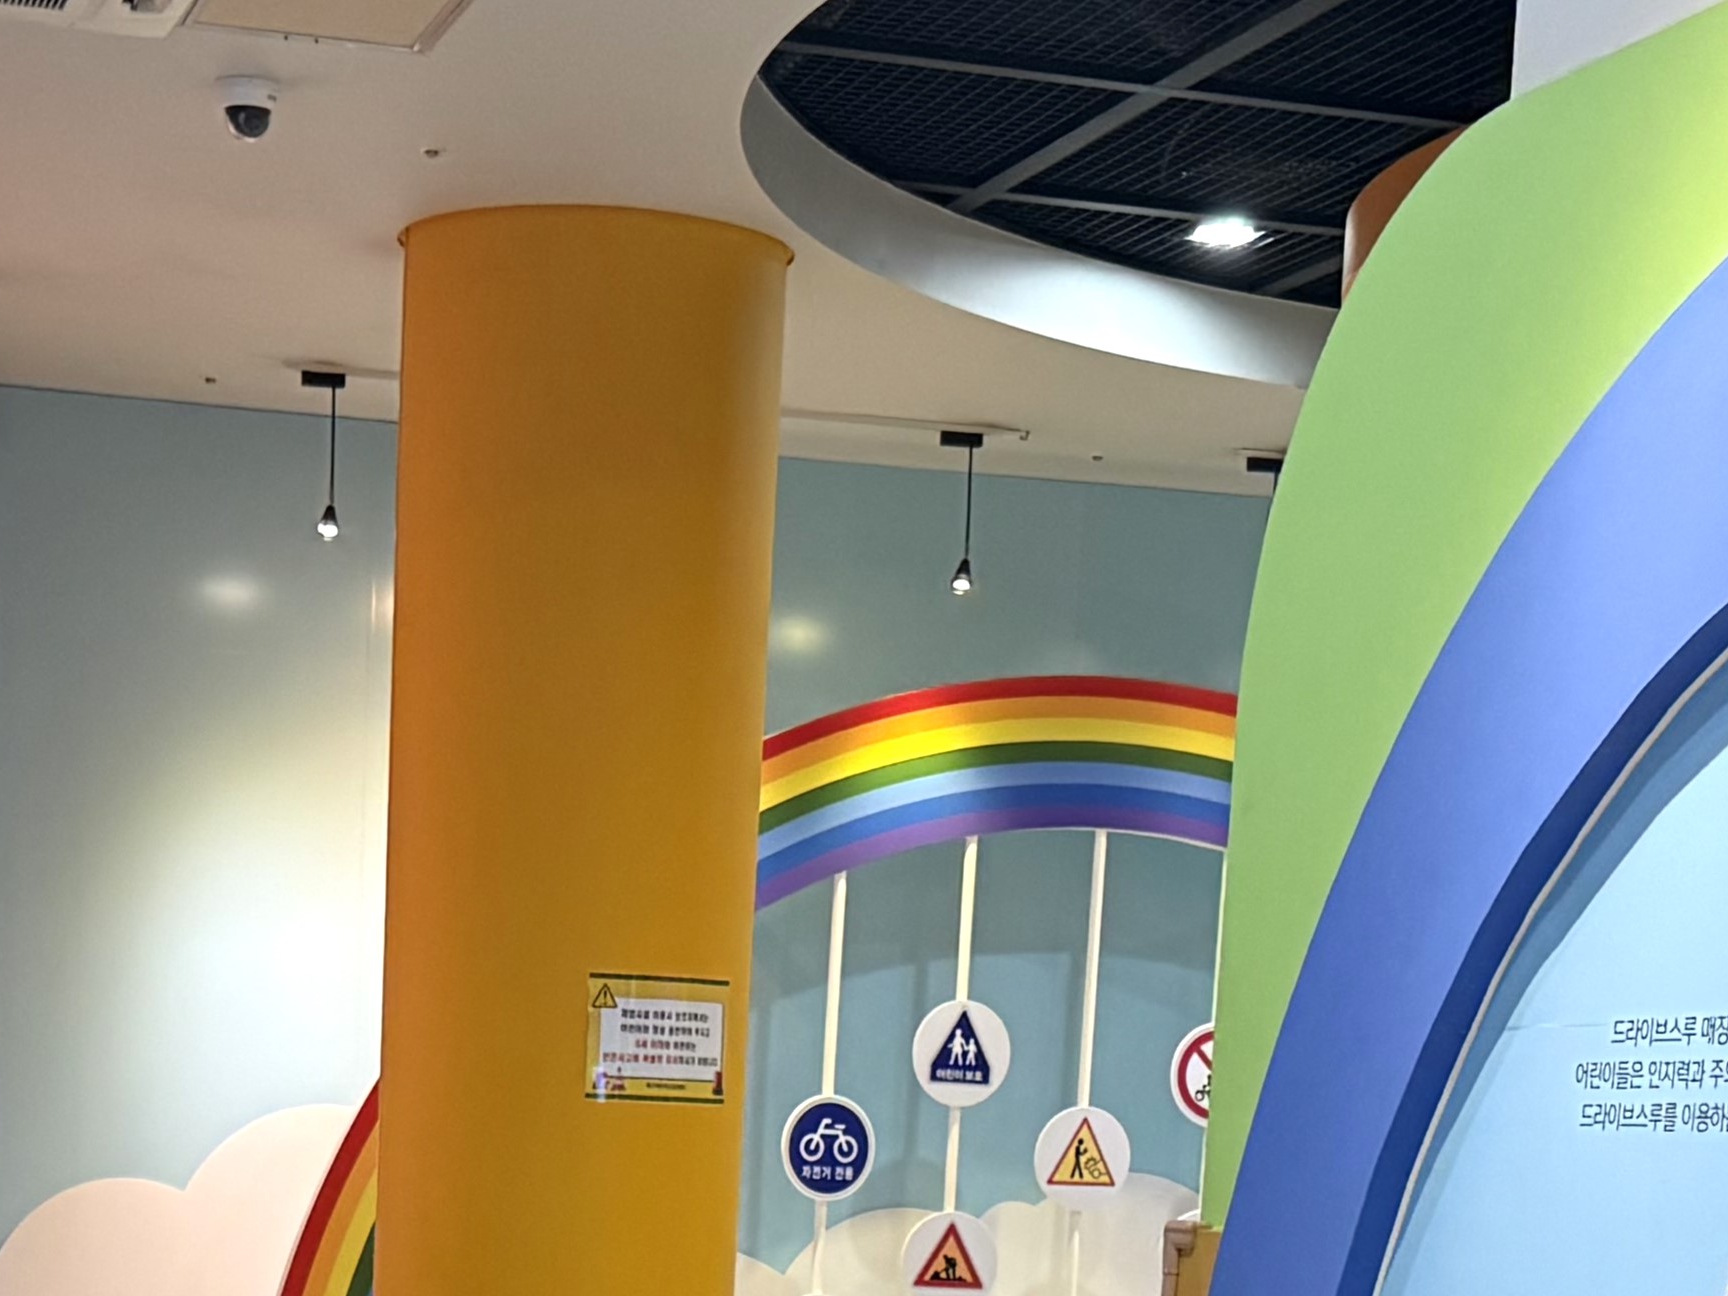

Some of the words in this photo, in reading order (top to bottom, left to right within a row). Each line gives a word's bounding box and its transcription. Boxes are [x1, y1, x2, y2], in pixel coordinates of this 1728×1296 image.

[1611, 1015, 1697, 1046] 드라이브스루
[1575, 1060, 1644, 1090] 어린이들은
[1648, 1058, 1705, 1090] 인지력과
[1579, 1102, 1677, 1132] 드라이브스루를
